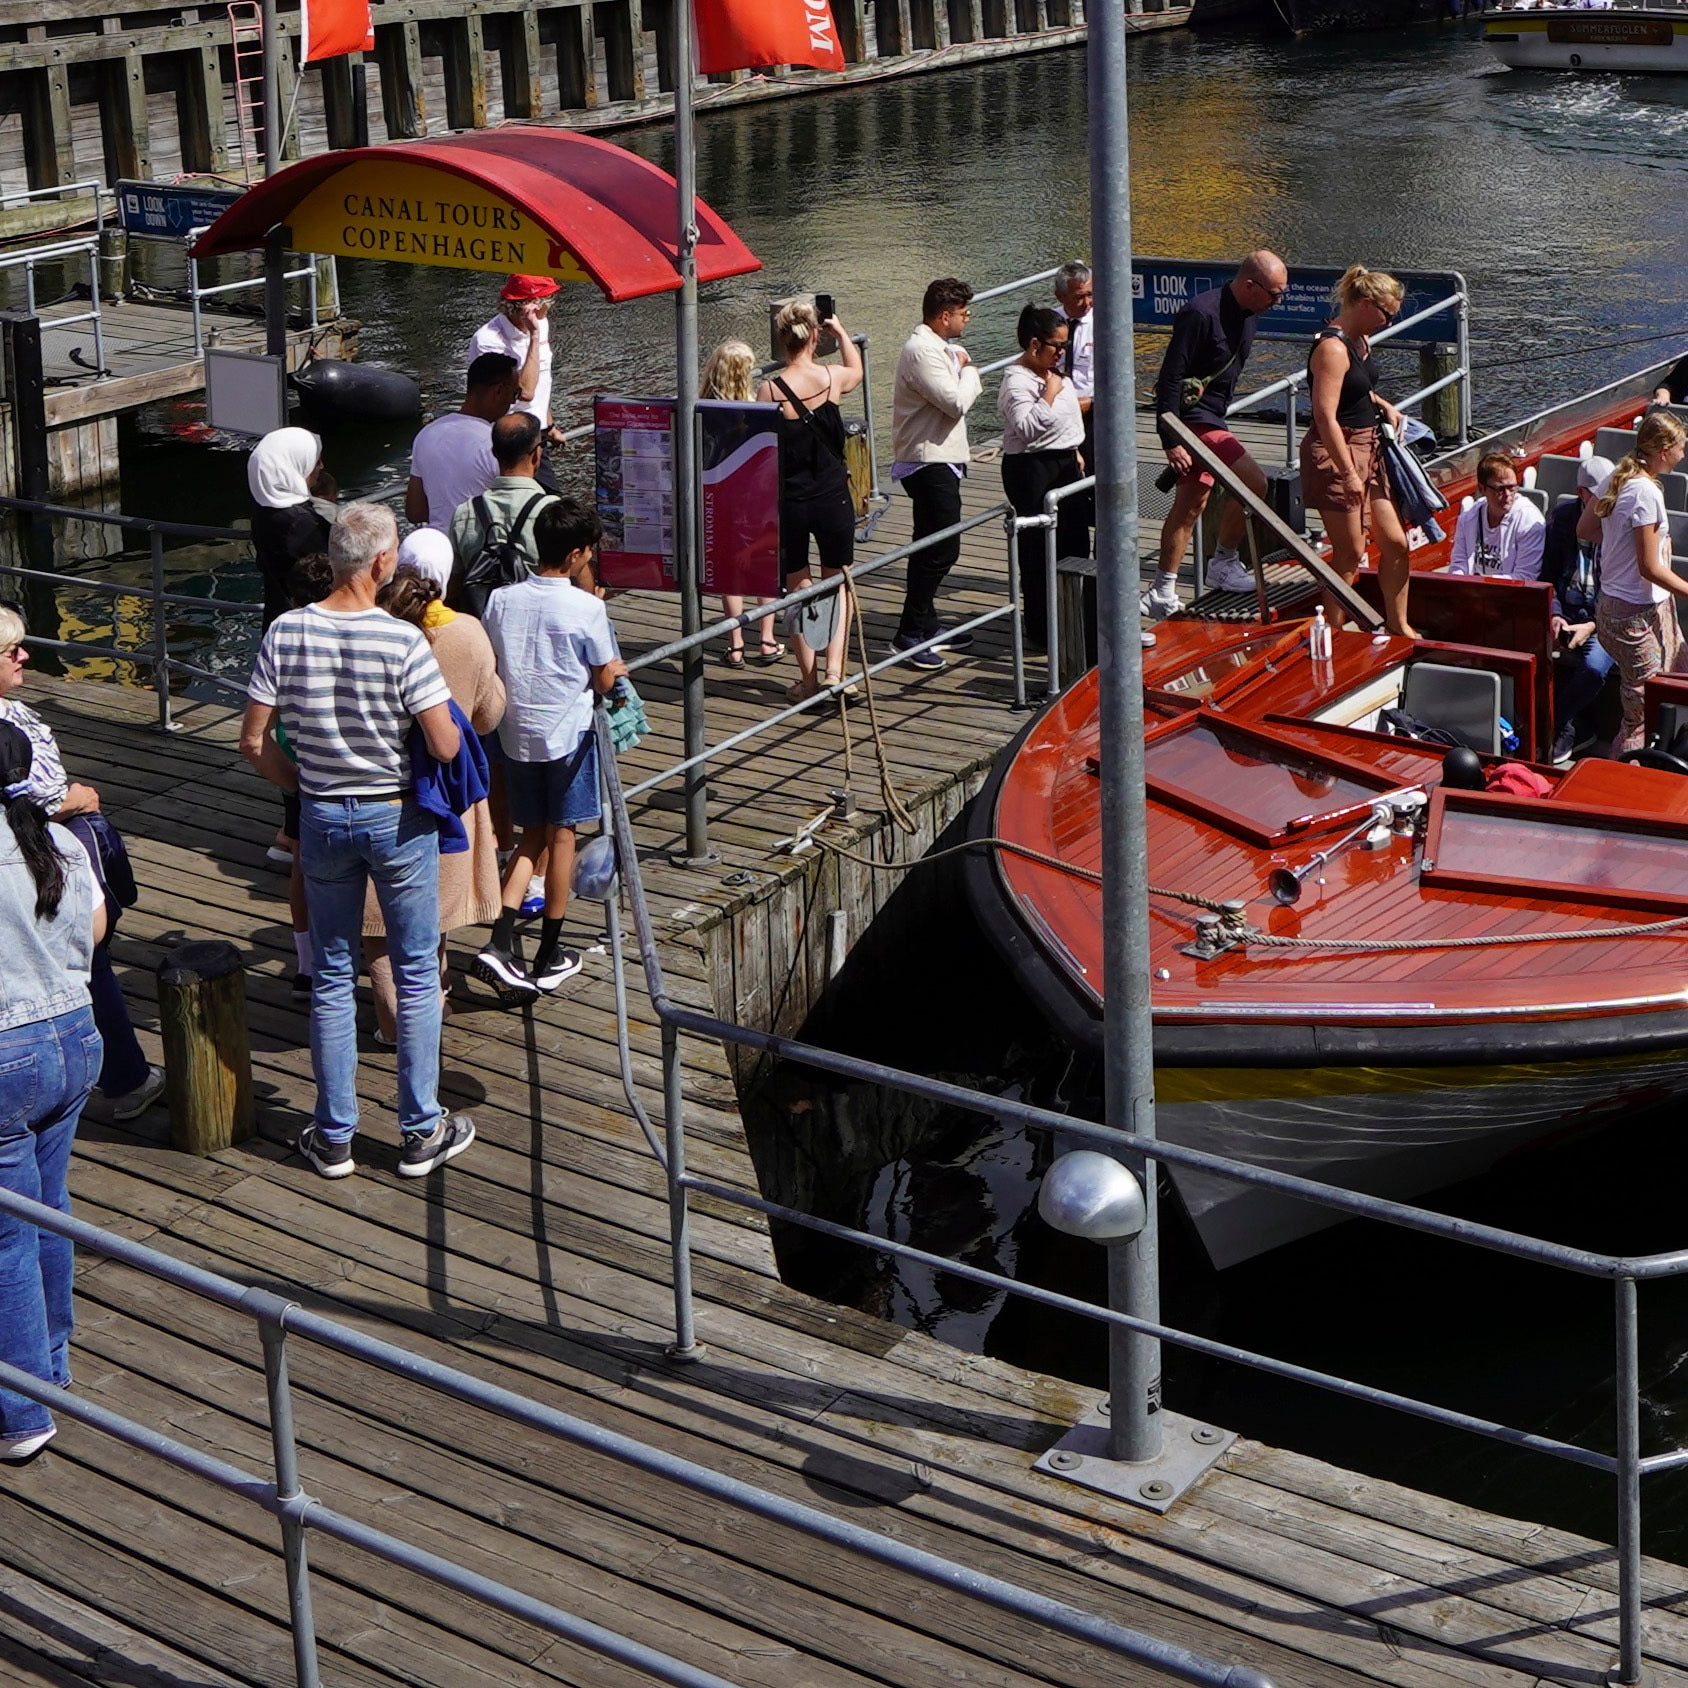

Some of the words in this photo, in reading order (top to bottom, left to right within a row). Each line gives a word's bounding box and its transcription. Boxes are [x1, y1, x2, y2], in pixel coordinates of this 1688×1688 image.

[143, 196, 166, 213] LOOK
[344, 194, 429, 223] CANAL
[434, 202, 522, 231] TOURS
[145, 213, 167, 227] DOWN
[342, 226, 526, 264] COPENHAGEN
[1153, 275, 1187, 297] LOOK
[1292, 283, 1304, 291] the
[1154, 297, 1188, 315] DOWN
[1287, 303, 1315, 312] surface
